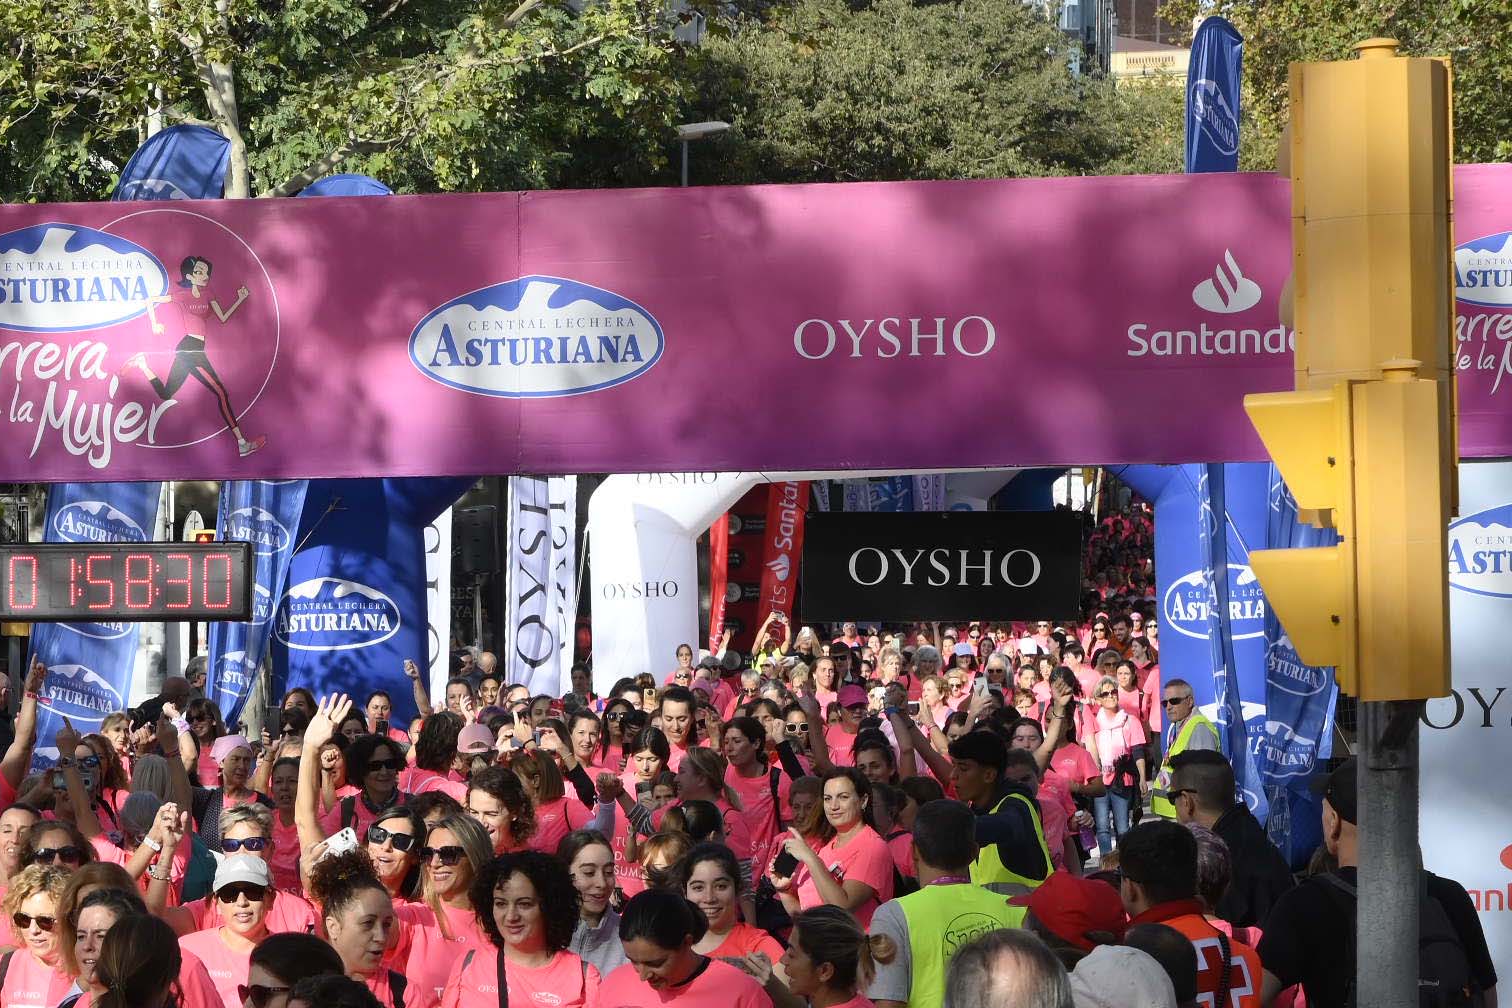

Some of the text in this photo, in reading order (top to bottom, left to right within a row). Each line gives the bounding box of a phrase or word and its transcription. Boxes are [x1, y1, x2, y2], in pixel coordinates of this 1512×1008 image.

[71, 259, 144, 272] LECHERA
[468, 317, 636, 332] CENTRAL LECHERA
[428, 323, 644, 367] ASTURIANA
[793, 315, 996, 360] OYSHO
[1127, 323, 1295, 357] Santand
[1477, 343, 1495, 369] la
[9, 383, 34, 423] la
[29, 374, 178, 469] Mujer
[848, 546, 1041, 587] OYSHO
[602, 580, 679, 600] OYSHO
[291, 602, 387, 610] CENTRAL LECHERA
[278, 611, 392, 635] ASTURIANA
[614, 864, 641, 878] SUM
